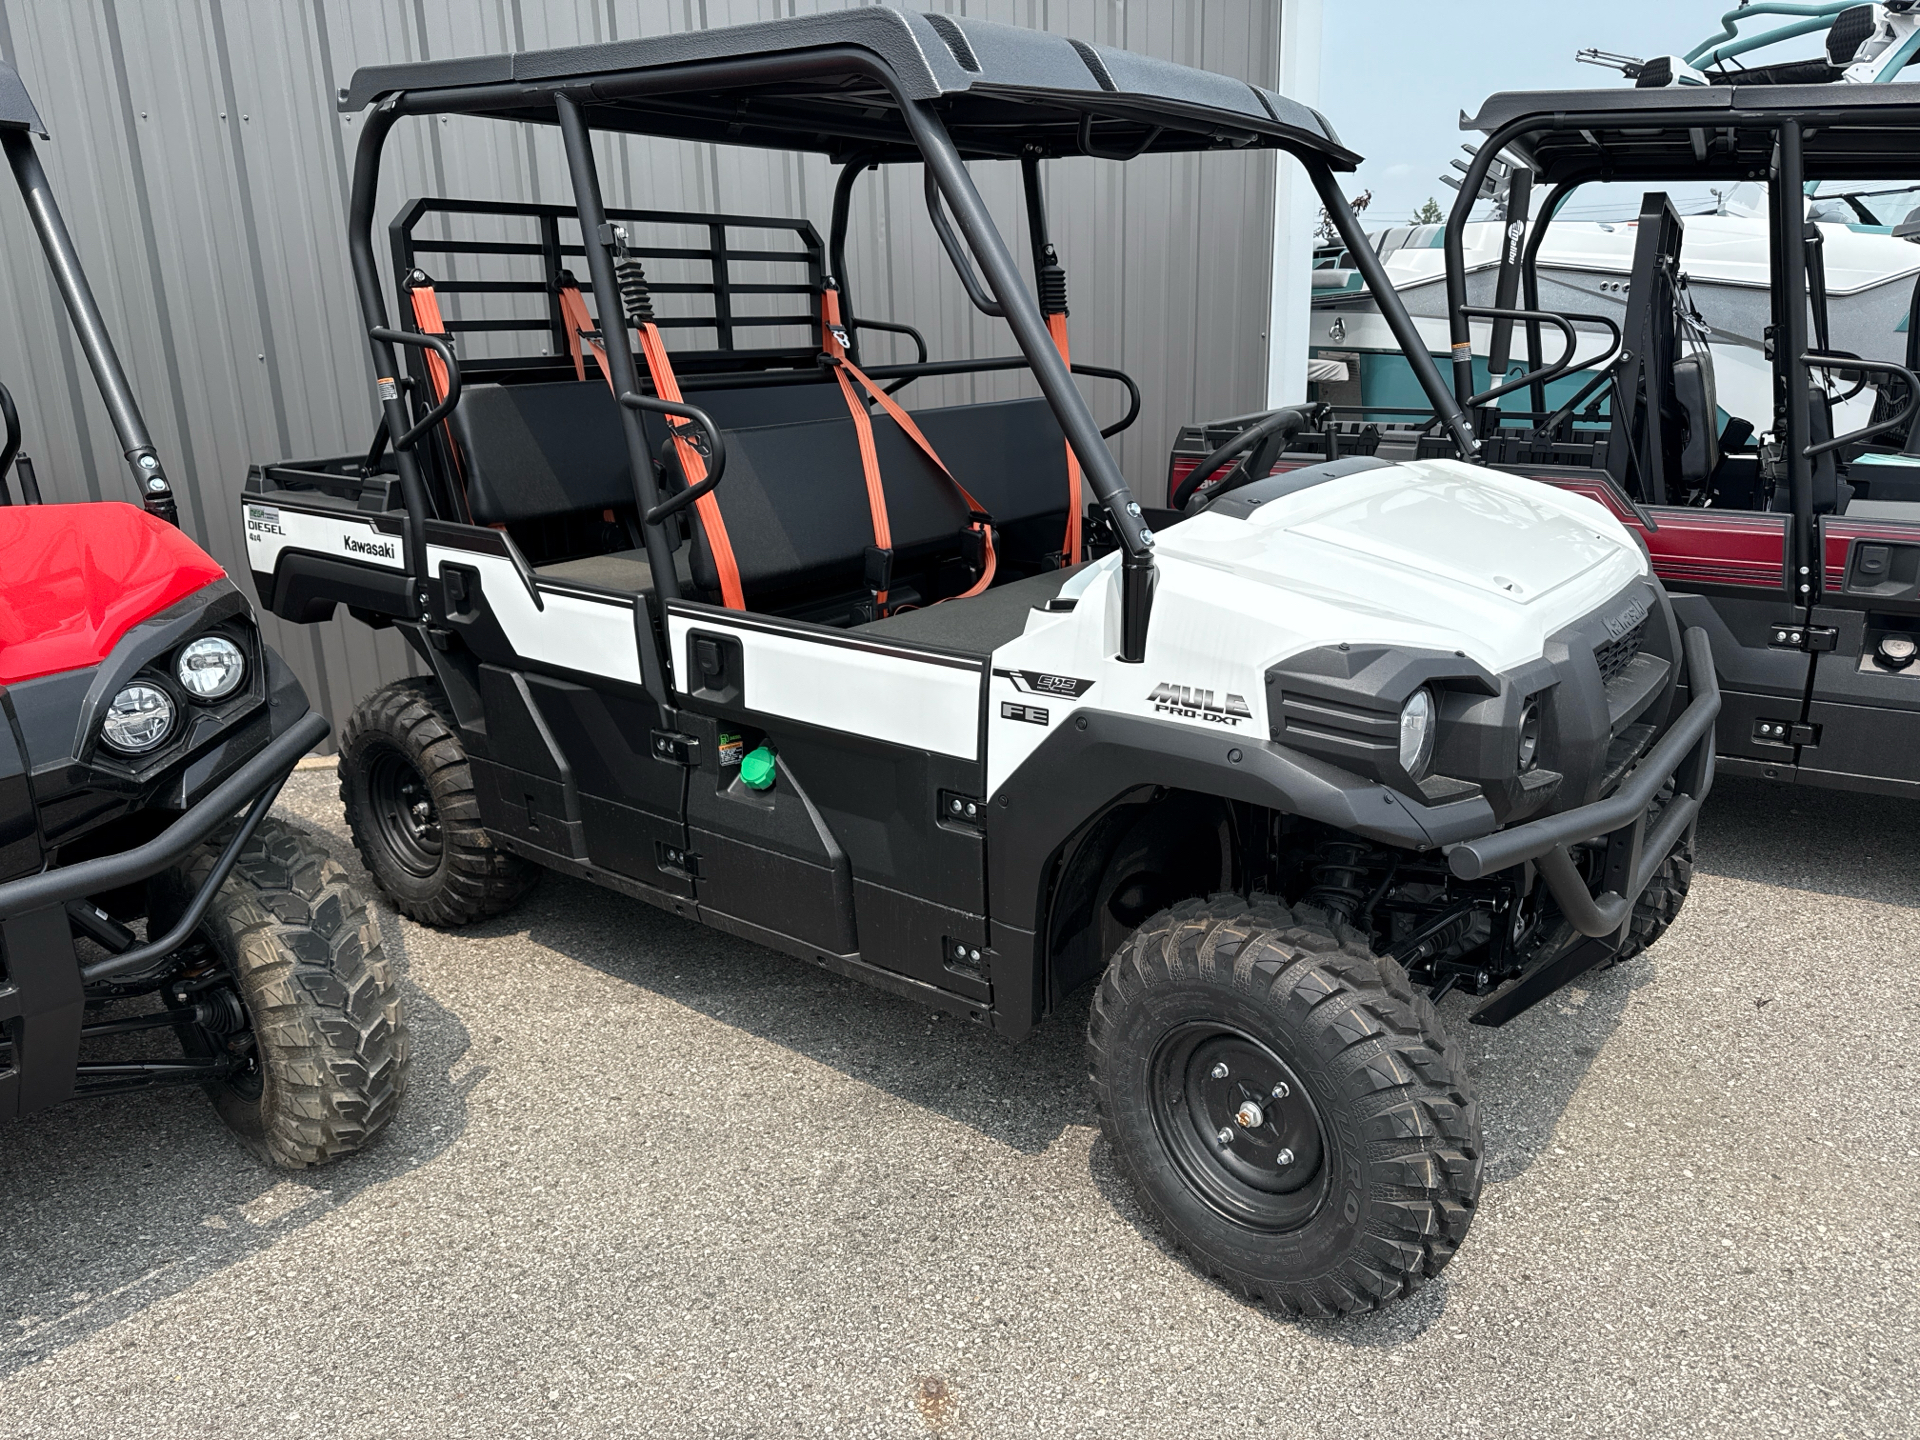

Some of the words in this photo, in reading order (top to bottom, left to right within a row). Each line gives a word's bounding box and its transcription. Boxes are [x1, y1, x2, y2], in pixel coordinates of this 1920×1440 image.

[247, 520, 286, 536] DIESEL
[249, 532, 262, 542] 4x4
[343, 534, 395, 559] Kawasaki
[1601, 596, 1647, 638] Kawasaki
[1037, 674, 1077, 690] EPS
[1145, 682, 1253, 719] MULE
[1002, 703, 1048, 724] FE
[1155, 704, 1242, 727] PRO-DXT
[1308, 1069, 1363, 1226] DURO
